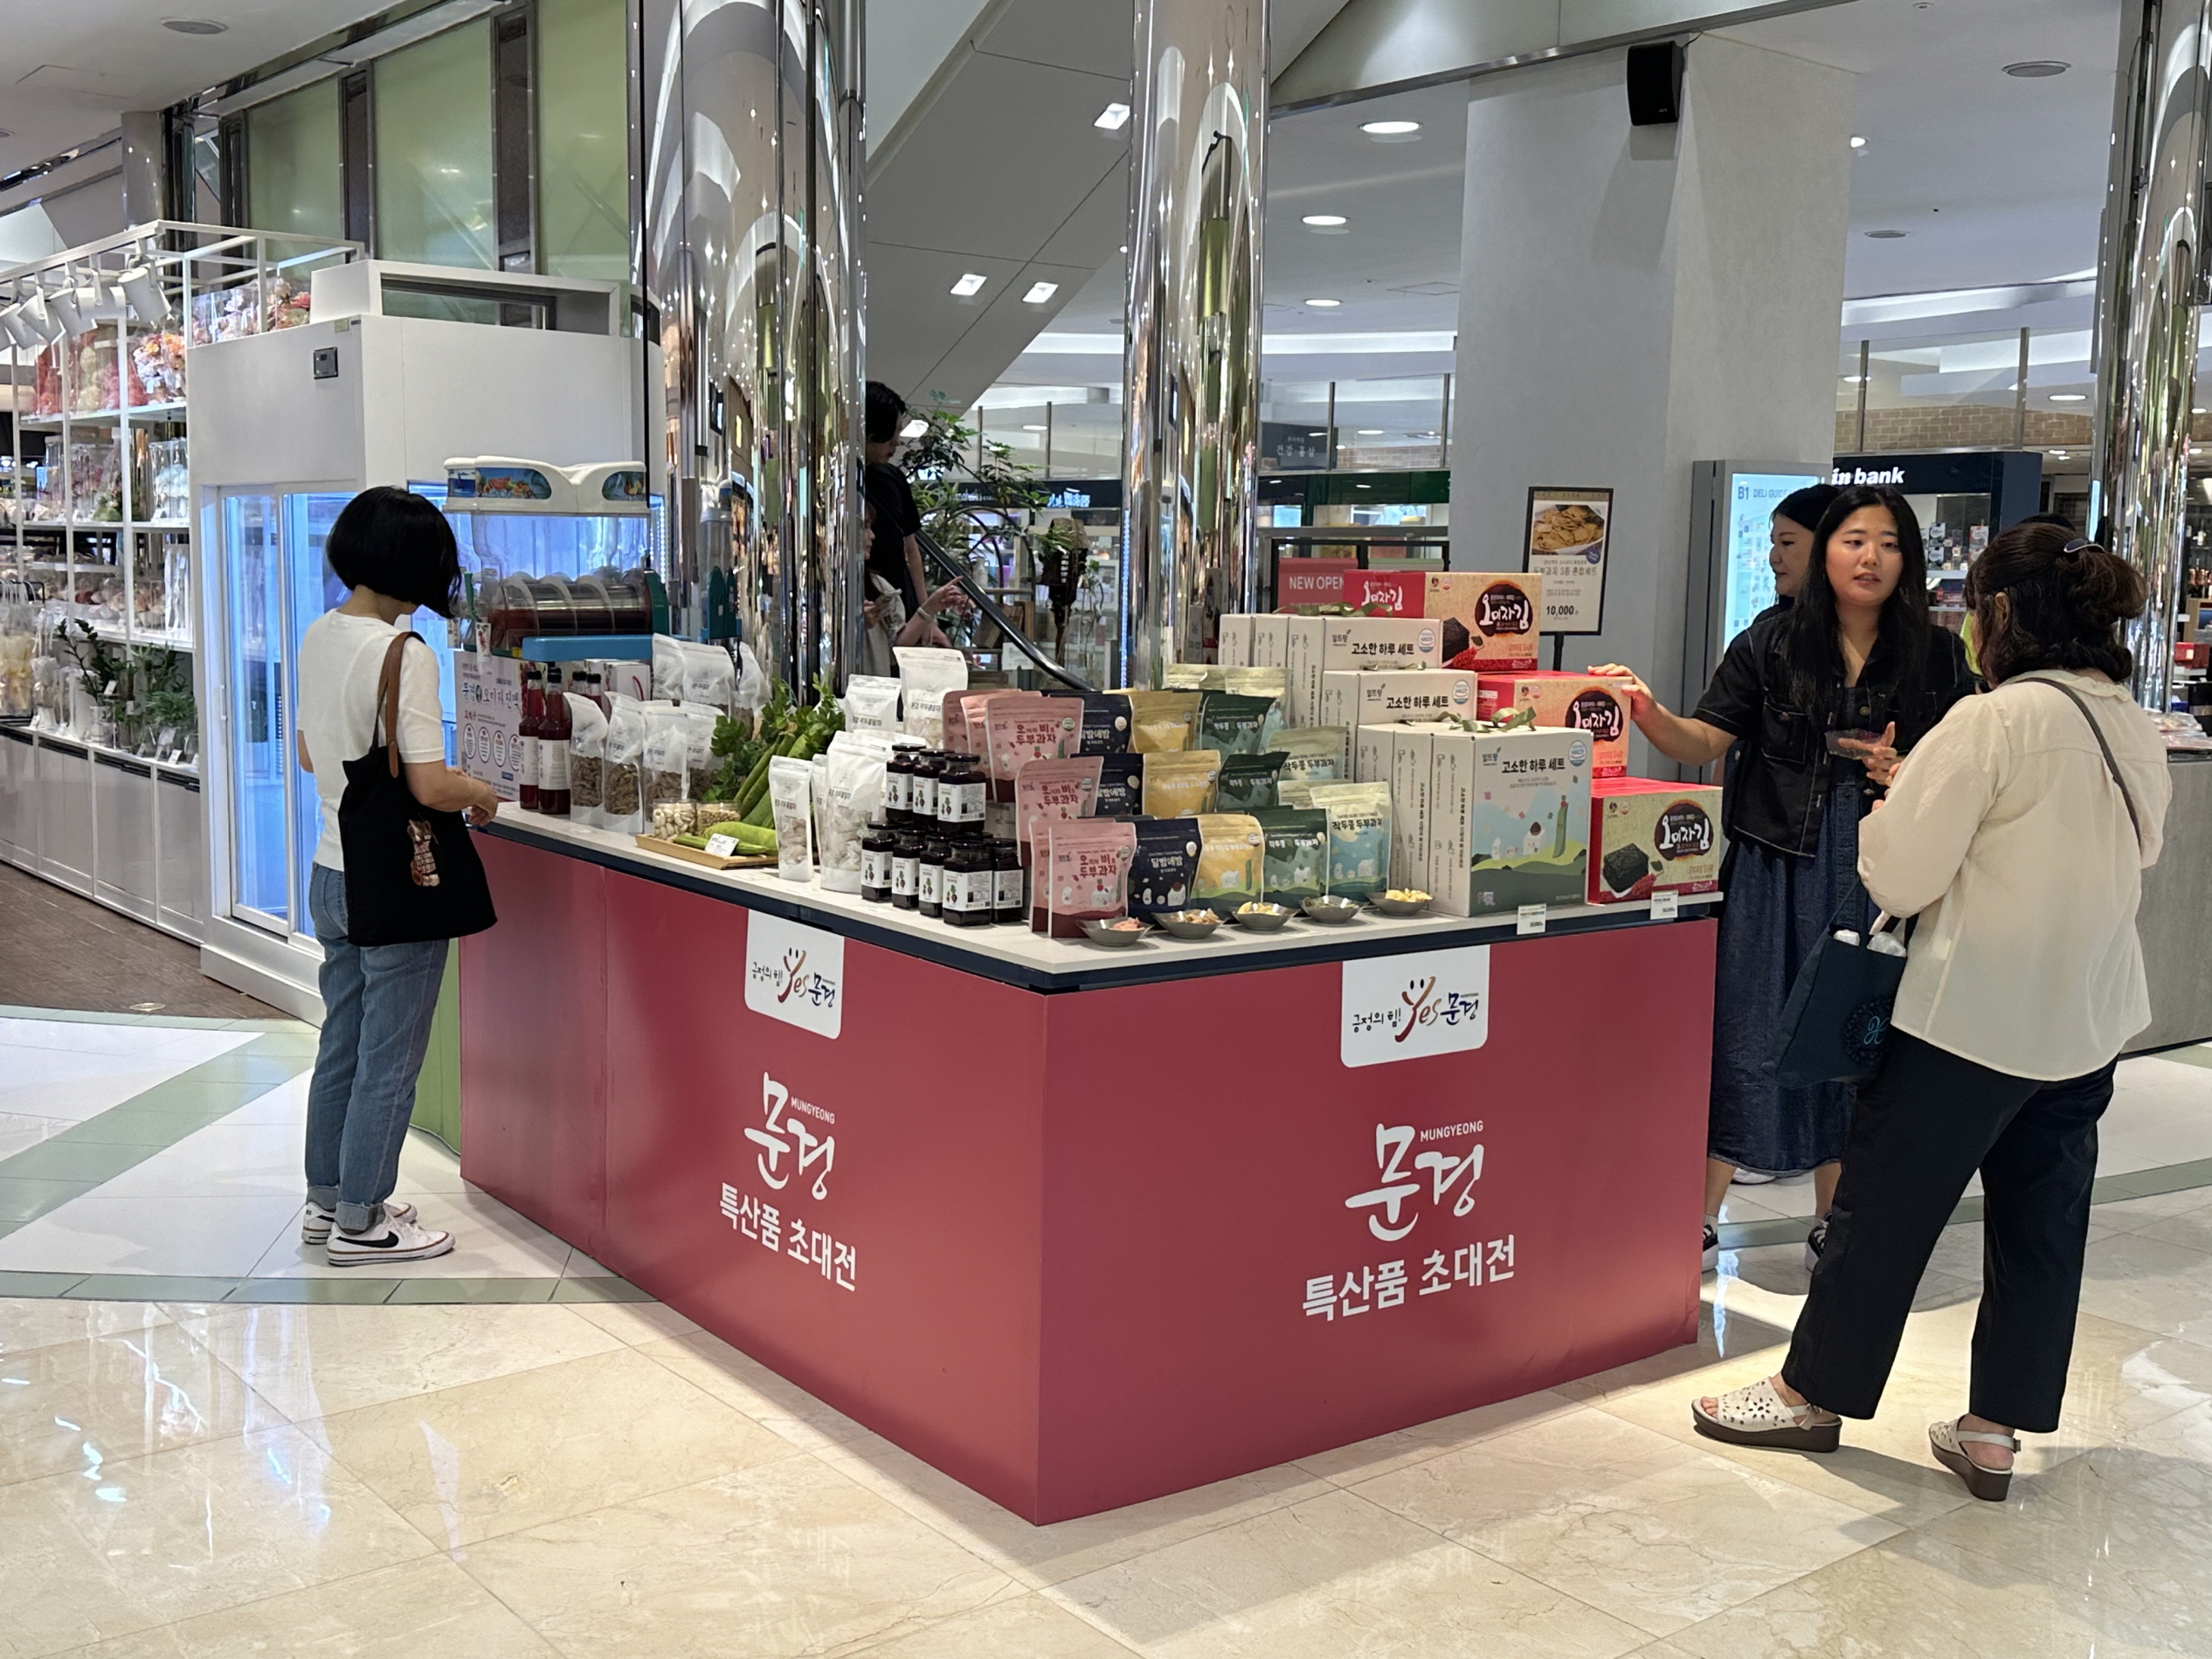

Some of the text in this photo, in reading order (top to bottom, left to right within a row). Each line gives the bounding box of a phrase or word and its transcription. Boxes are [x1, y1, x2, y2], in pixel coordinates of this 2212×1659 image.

[1854, 467, 1905, 485] bank
[1738, 487, 1749, 500] B1
[1289, 577, 1314, 590] NEW
[1479, 593, 1530, 630] 오미자김
[1545, 605, 1574, 617] 10,000
[1351, 643, 1414, 655] 고소한 하루 세트
[1386, 695, 1449, 709] 고소한 하루 세트
[1016, 734, 1056, 745] 두부과자
[1307, 758, 1335, 769] 두부과자
[1502, 757, 1565, 773] 고소한 하루 세트
[1044, 795, 1079, 805] 두부과자
[1331, 818, 1382, 831] 작두콩 두부과자
[1659, 814, 1711, 850] 오미자김
[1079, 865, 1116, 878] 두부과자
[751, 961, 784, 987] 긍정의 힘!
[778, 947, 809, 1003] Yes
[807, 971, 835, 1008] 문경
[1352, 1007, 1401, 1033] 긍정의 힘!
[1394, 976, 1441, 1042] Yes
[1440, 992, 1479, 1026] 문경
[791, 1096, 835, 1125] MUNGYEONG
[743, 1071, 835, 1200] 문경
[1420, 1120, 1483, 1142] MUNGYEONG
[1345, 1123, 1484, 1241] 문경
[720, 1182, 856, 1292] 특산품 초대전
[1303, 1234, 1515, 1321] 특산품 초대전
